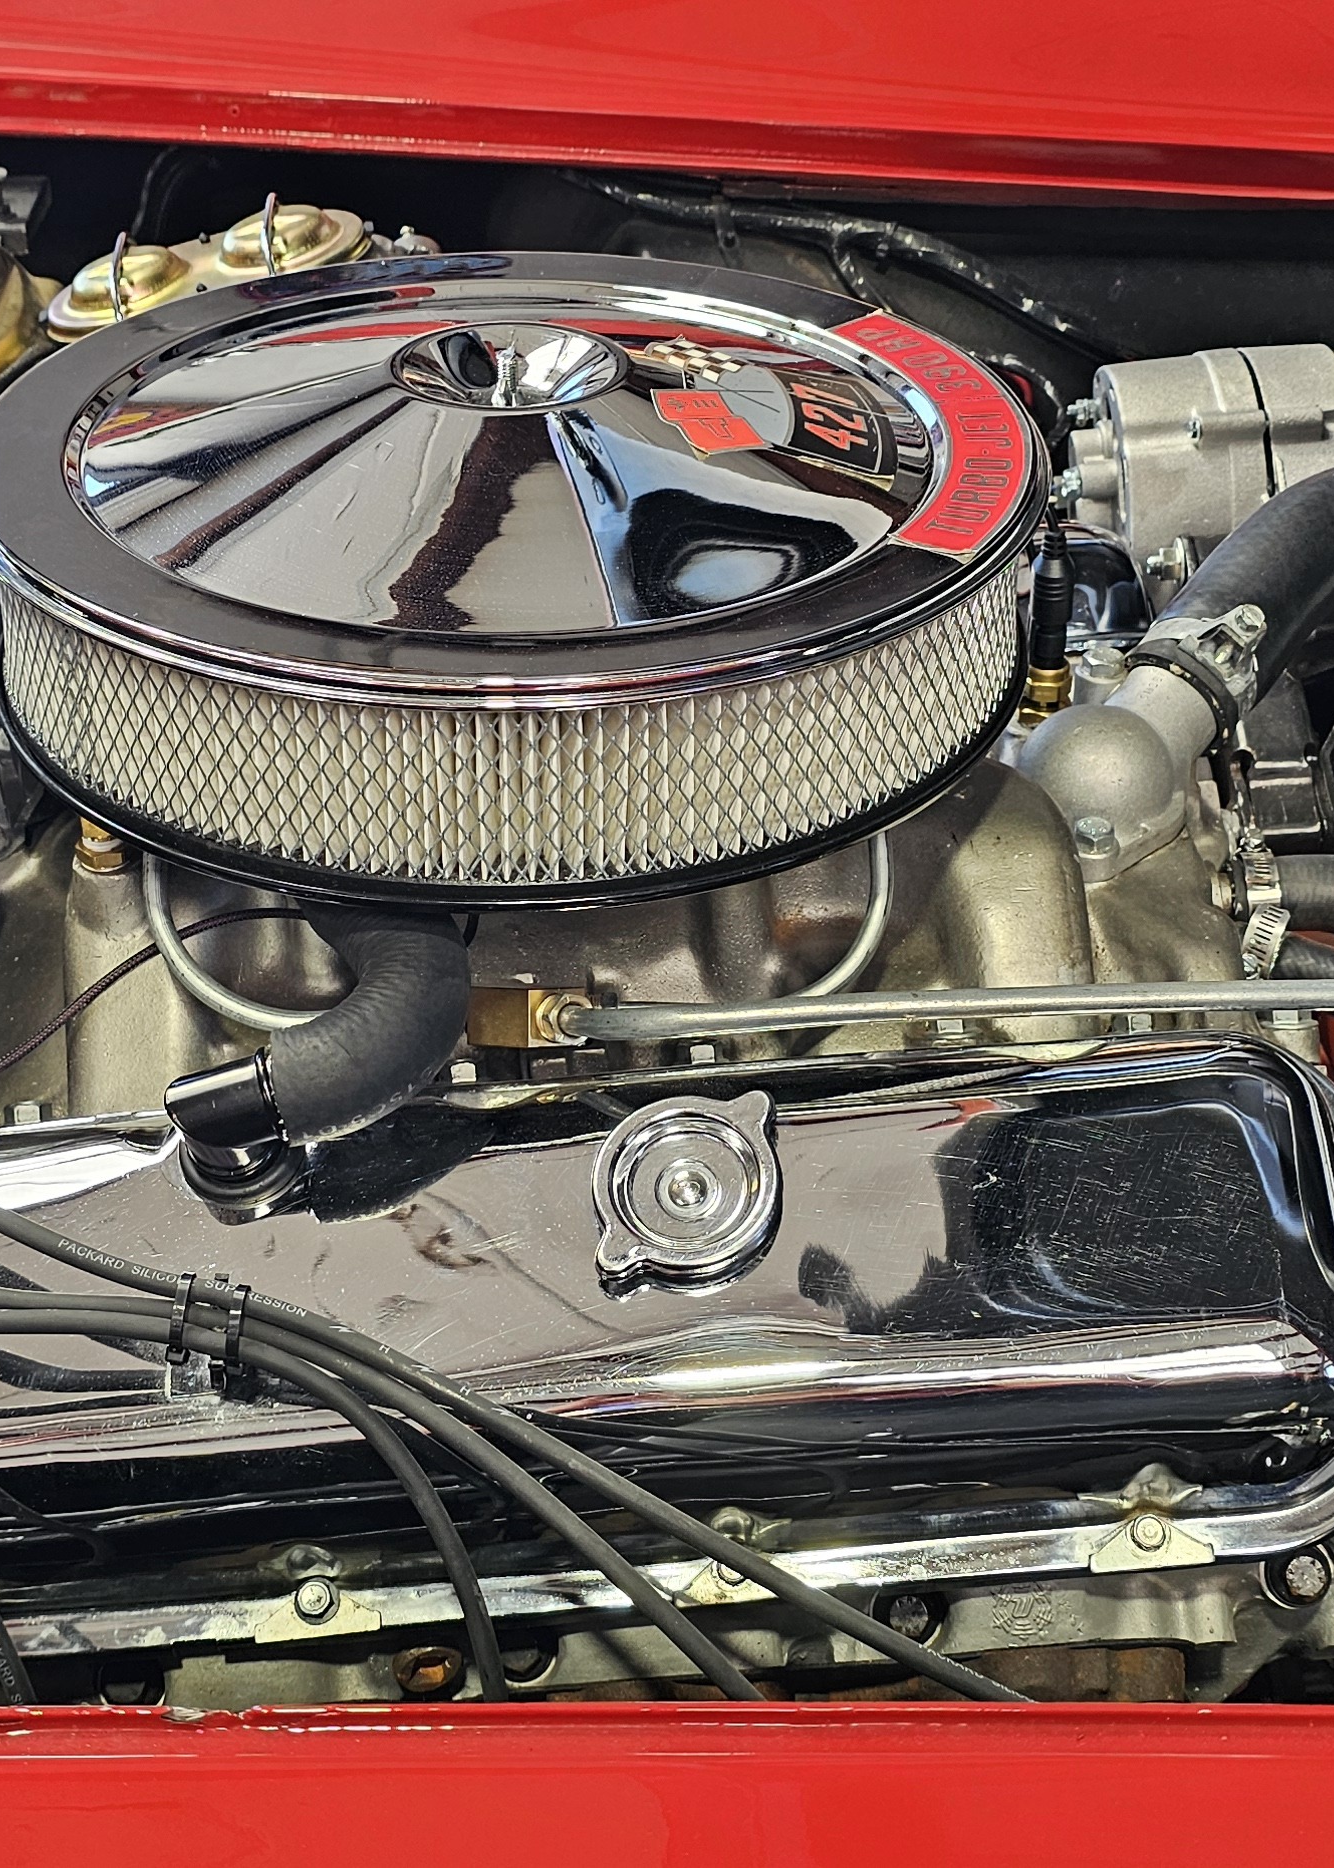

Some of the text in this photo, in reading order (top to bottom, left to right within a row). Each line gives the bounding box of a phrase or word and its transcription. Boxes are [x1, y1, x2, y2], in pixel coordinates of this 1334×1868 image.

[856, 327, 922, 352] HP
[902, 351, 982, 393] 390
[790, 382, 869, 451] 427
[57, 1238, 308, 1318] PACKARD SILICO SUPRESSION
